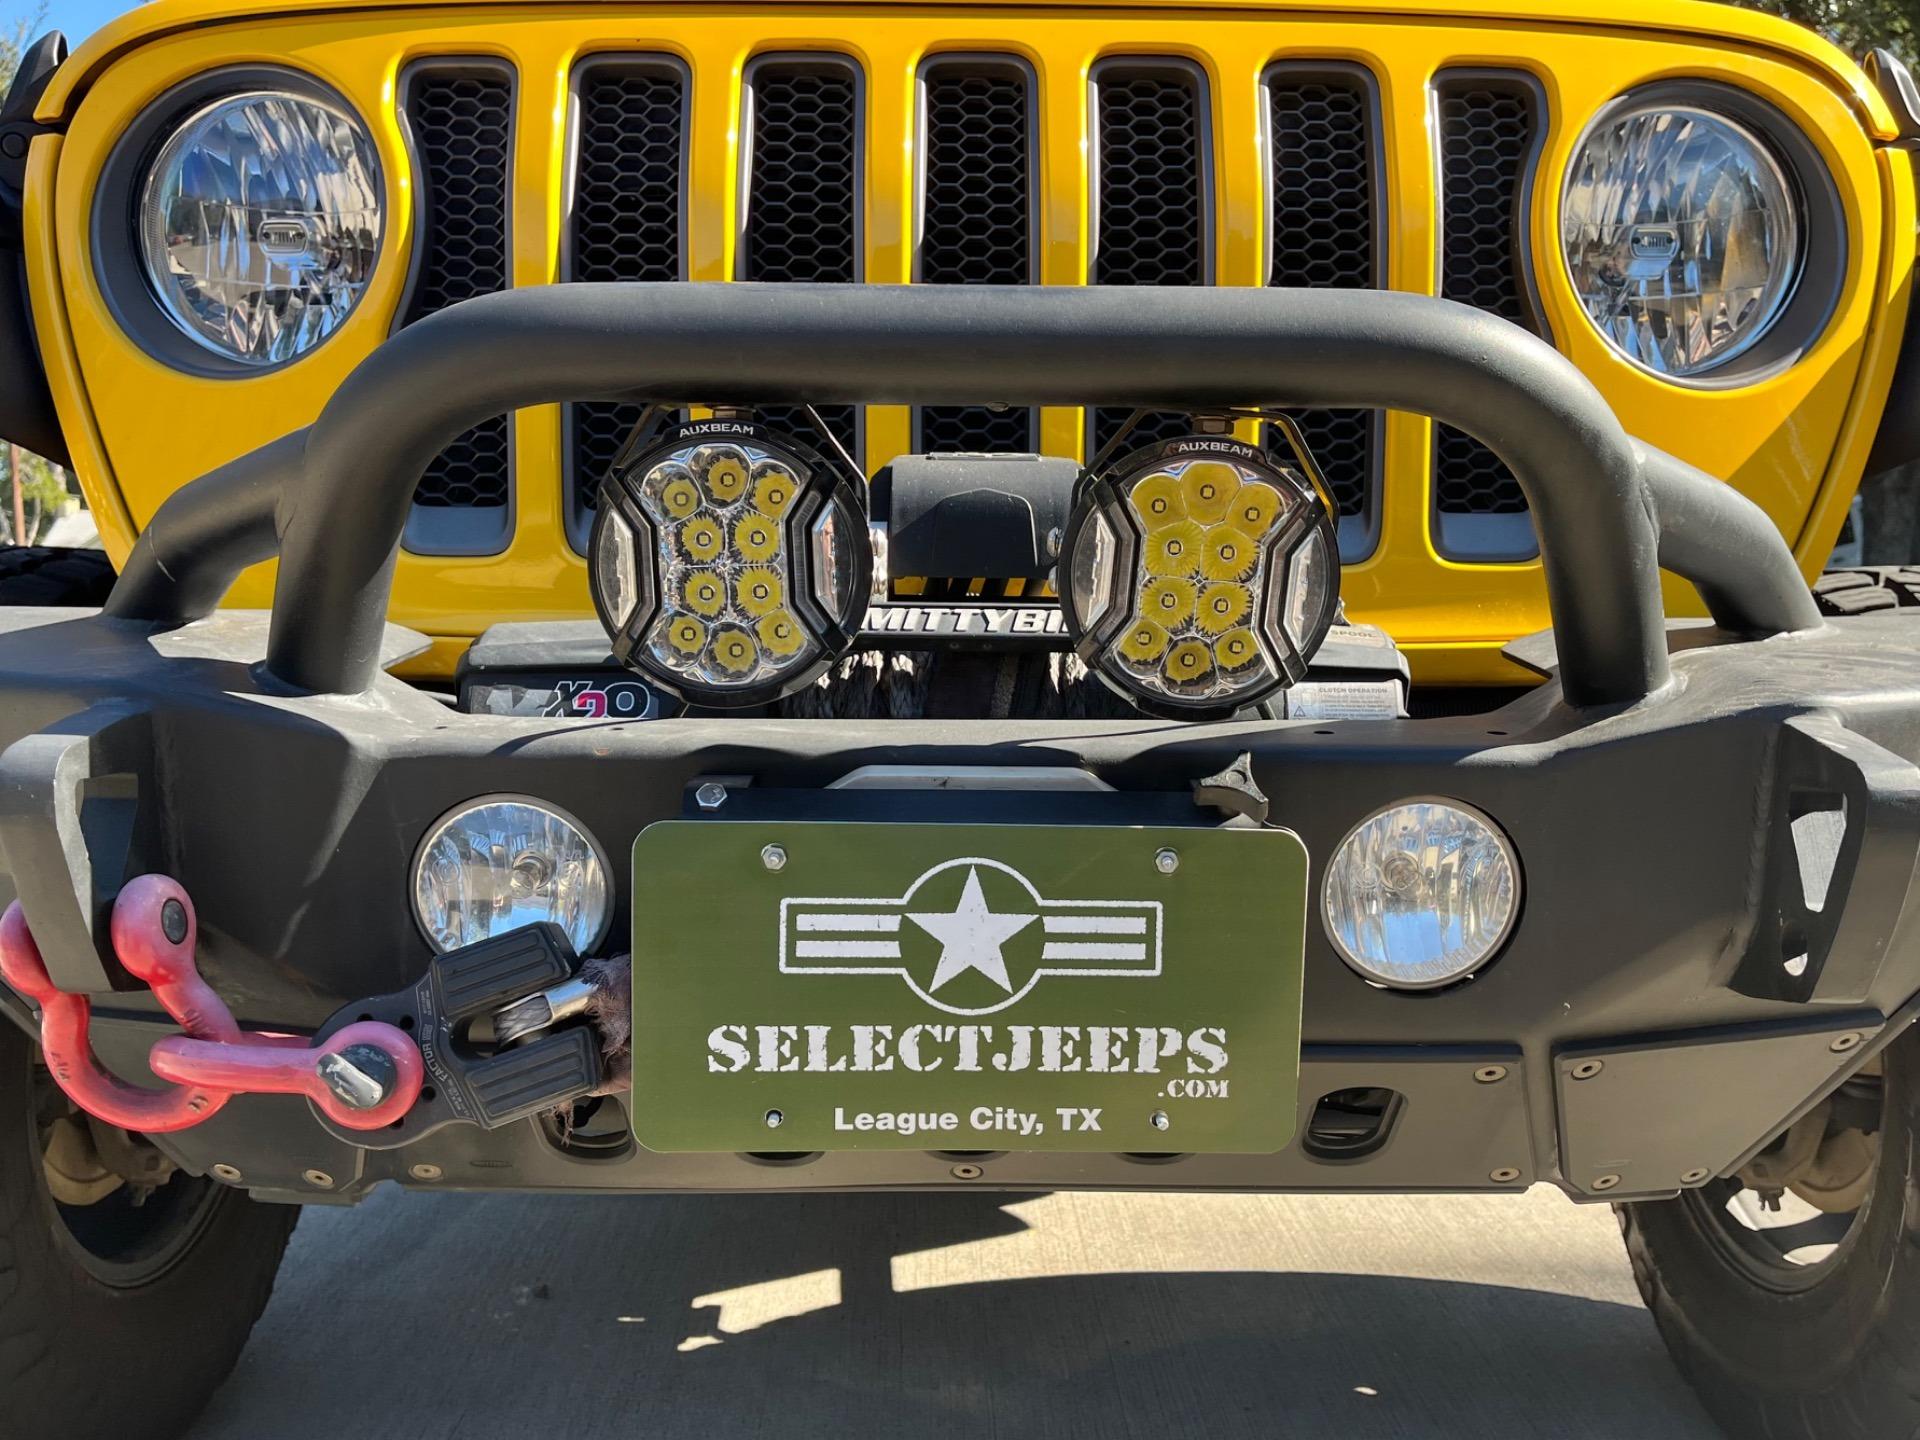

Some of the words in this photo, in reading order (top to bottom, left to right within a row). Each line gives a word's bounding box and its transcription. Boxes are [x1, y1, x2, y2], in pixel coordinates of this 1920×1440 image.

[679, 423, 754, 438] AUXBEAM
[1178, 441, 1253, 458] AUXBEAM
[861, 607, 1069, 632] MITTYBI
[707, 1024, 1229, 1074] SELECTJEEPS
[422, 1043, 449, 1082] FACTOR
[1157, 1079, 1230, 1098] .COM
[834, 1107, 959, 1135] League
[969, 1106, 1044, 1136] City,
[1056, 1107, 1103, 1132] TX
